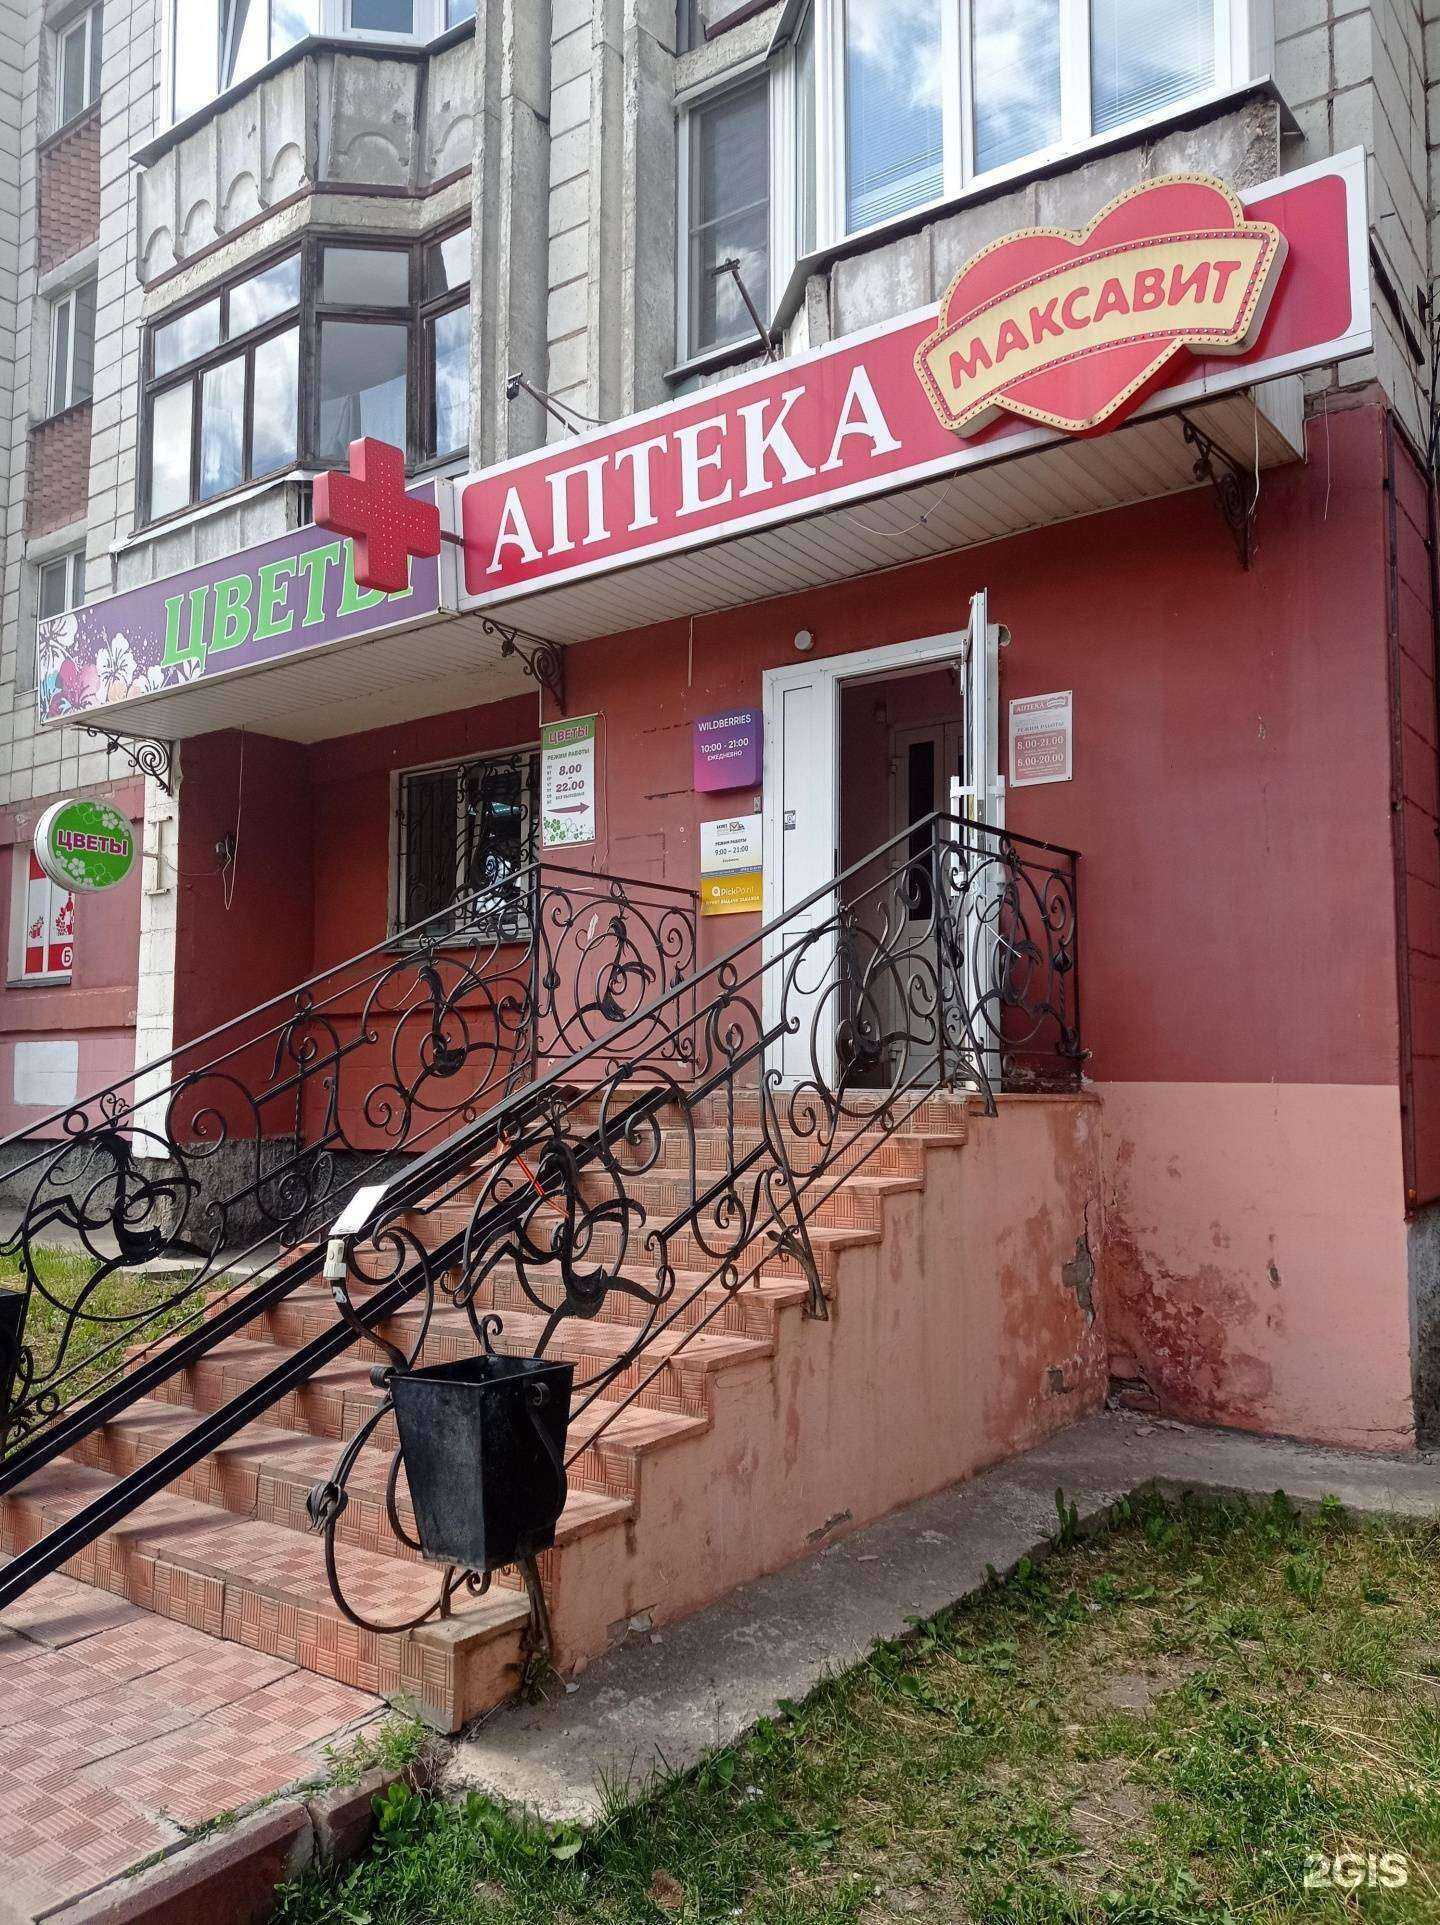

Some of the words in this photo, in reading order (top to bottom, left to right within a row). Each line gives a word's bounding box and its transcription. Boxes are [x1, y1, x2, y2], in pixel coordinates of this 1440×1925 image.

[948, 259, 1242, 390] МАКСАВИТ
[484, 364, 902, 575] АПТЕКА
[698, 714, 752, 732] WILDBERRIES
[548, 725, 589, 744] ЦВЕТЫ
[700, 742, 722, 754] 10:00
[728, 737, 749, 749] 21:00
[559, 763, 582, 776] 8.00
[555, 780, 585, 793] 22.00
[57, 830, 129, 857] ЦВЕТЫ
